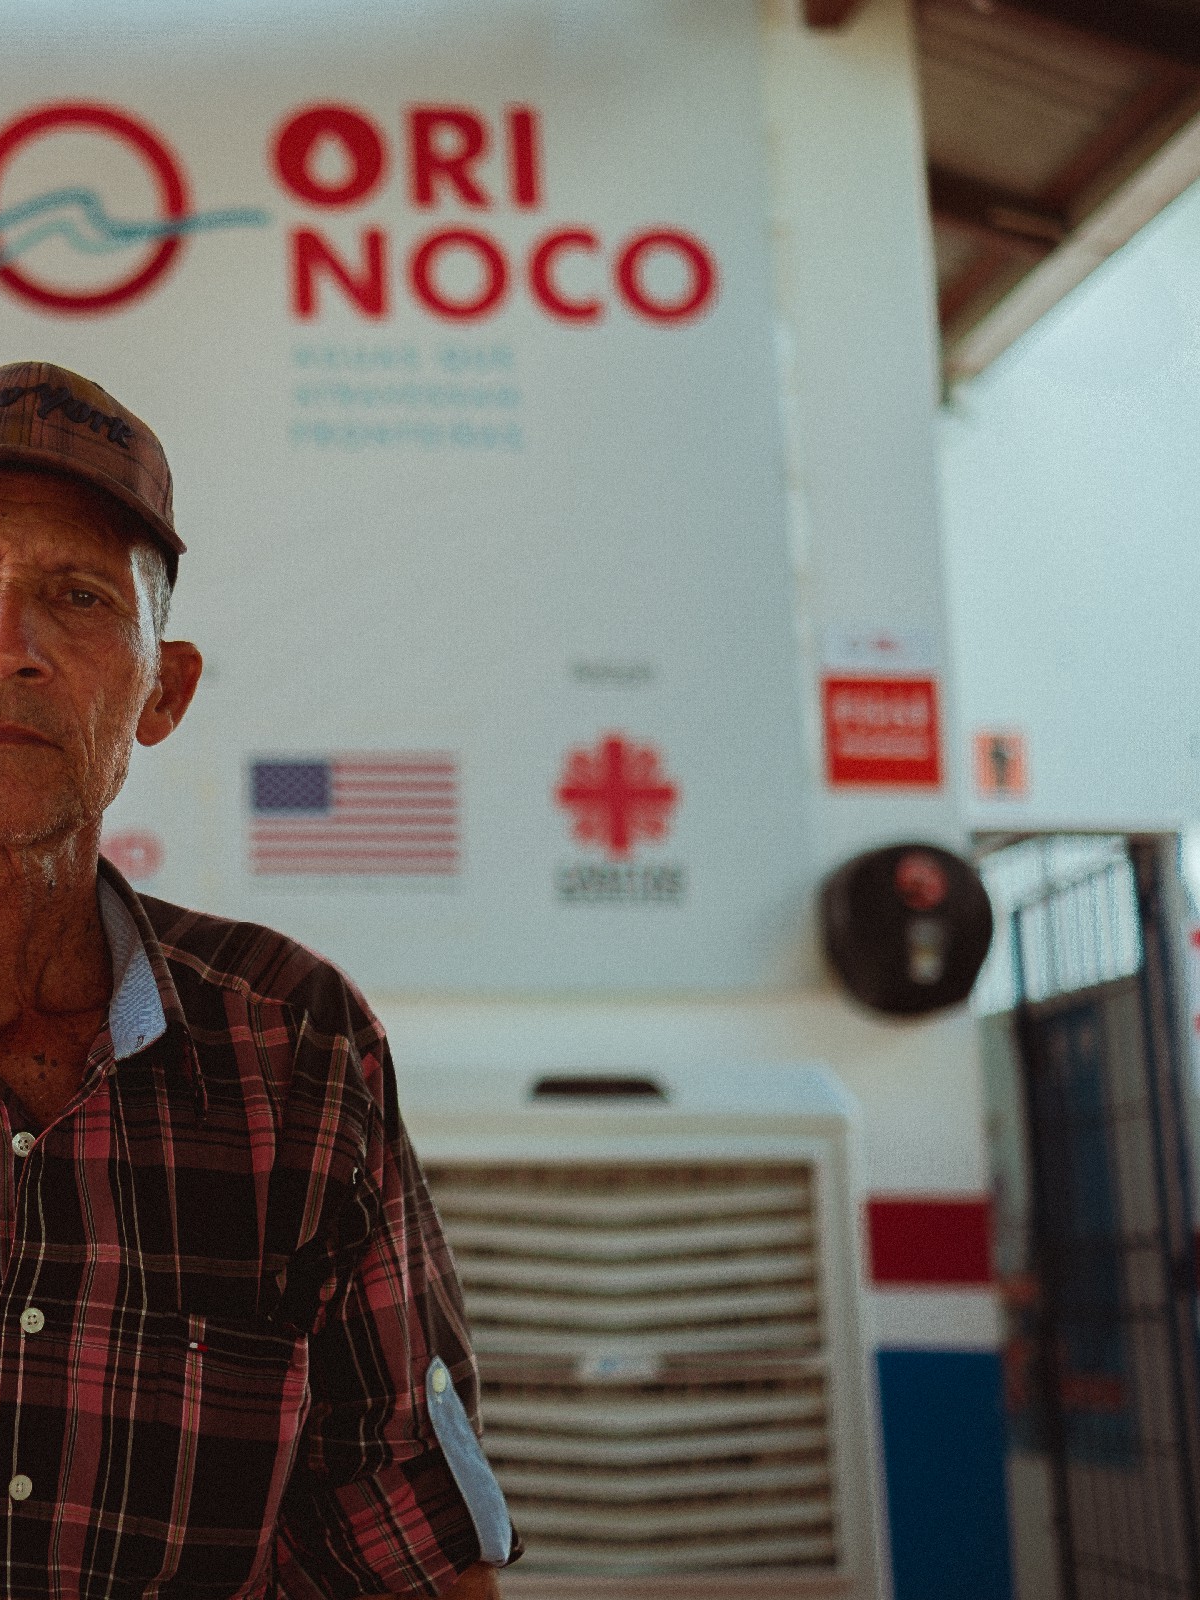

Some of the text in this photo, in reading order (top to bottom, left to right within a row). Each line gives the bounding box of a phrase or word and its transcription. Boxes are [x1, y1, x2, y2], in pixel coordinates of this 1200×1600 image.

[272, 103, 542, 210] ORI
[291, 226, 717, 324] NOCO
[31, 382, 135, 449] York
